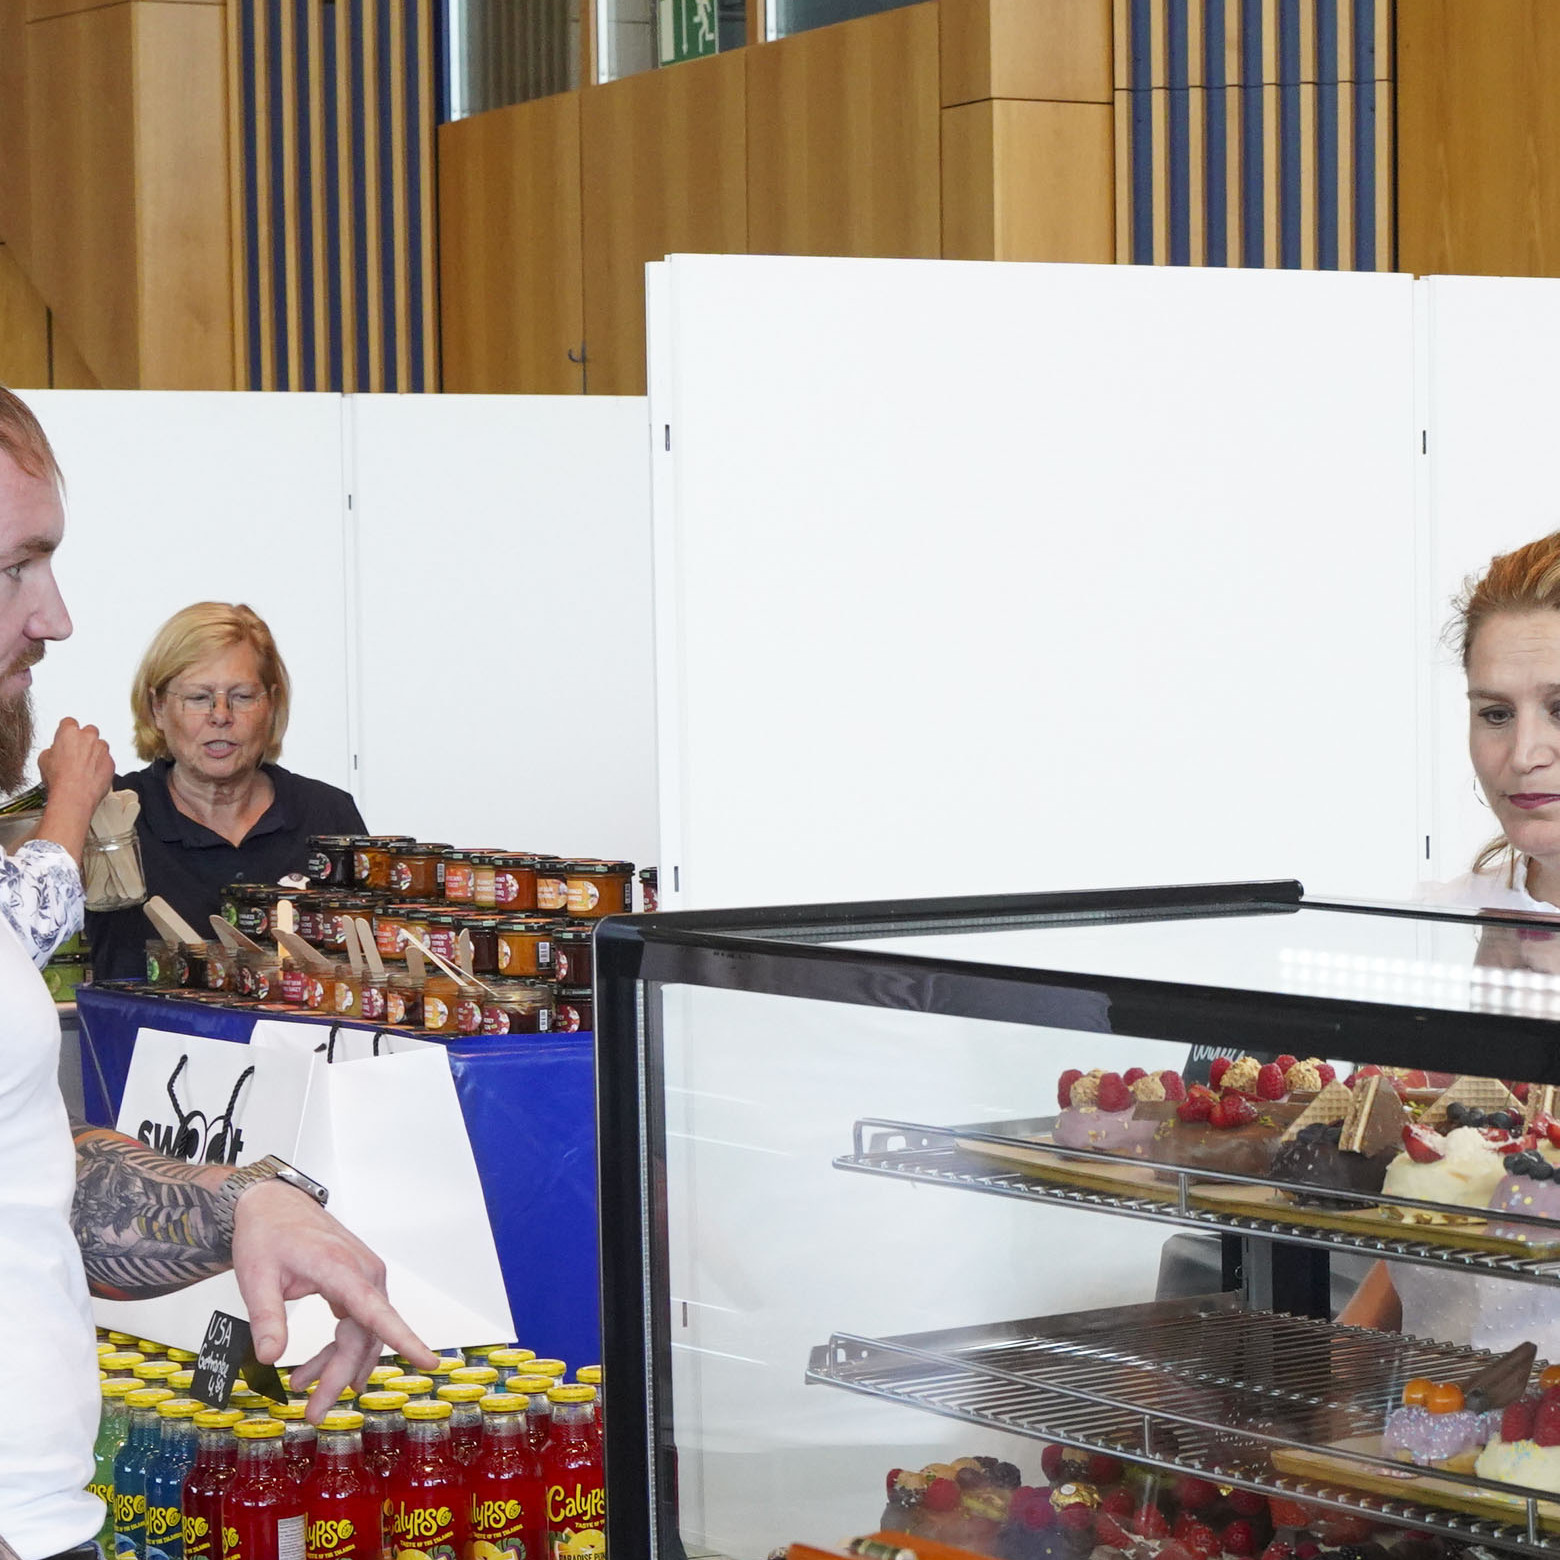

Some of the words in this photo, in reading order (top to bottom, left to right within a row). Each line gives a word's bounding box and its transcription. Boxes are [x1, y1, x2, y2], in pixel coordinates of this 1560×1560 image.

[208, 1313, 232, 1348] USA
[393, 1501, 452, 1539] alypso
[472, 1493, 521, 1531] lypso
[547, 1483, 605, 1522] Calyp
[305, 1511, 354, 1550] lypso
